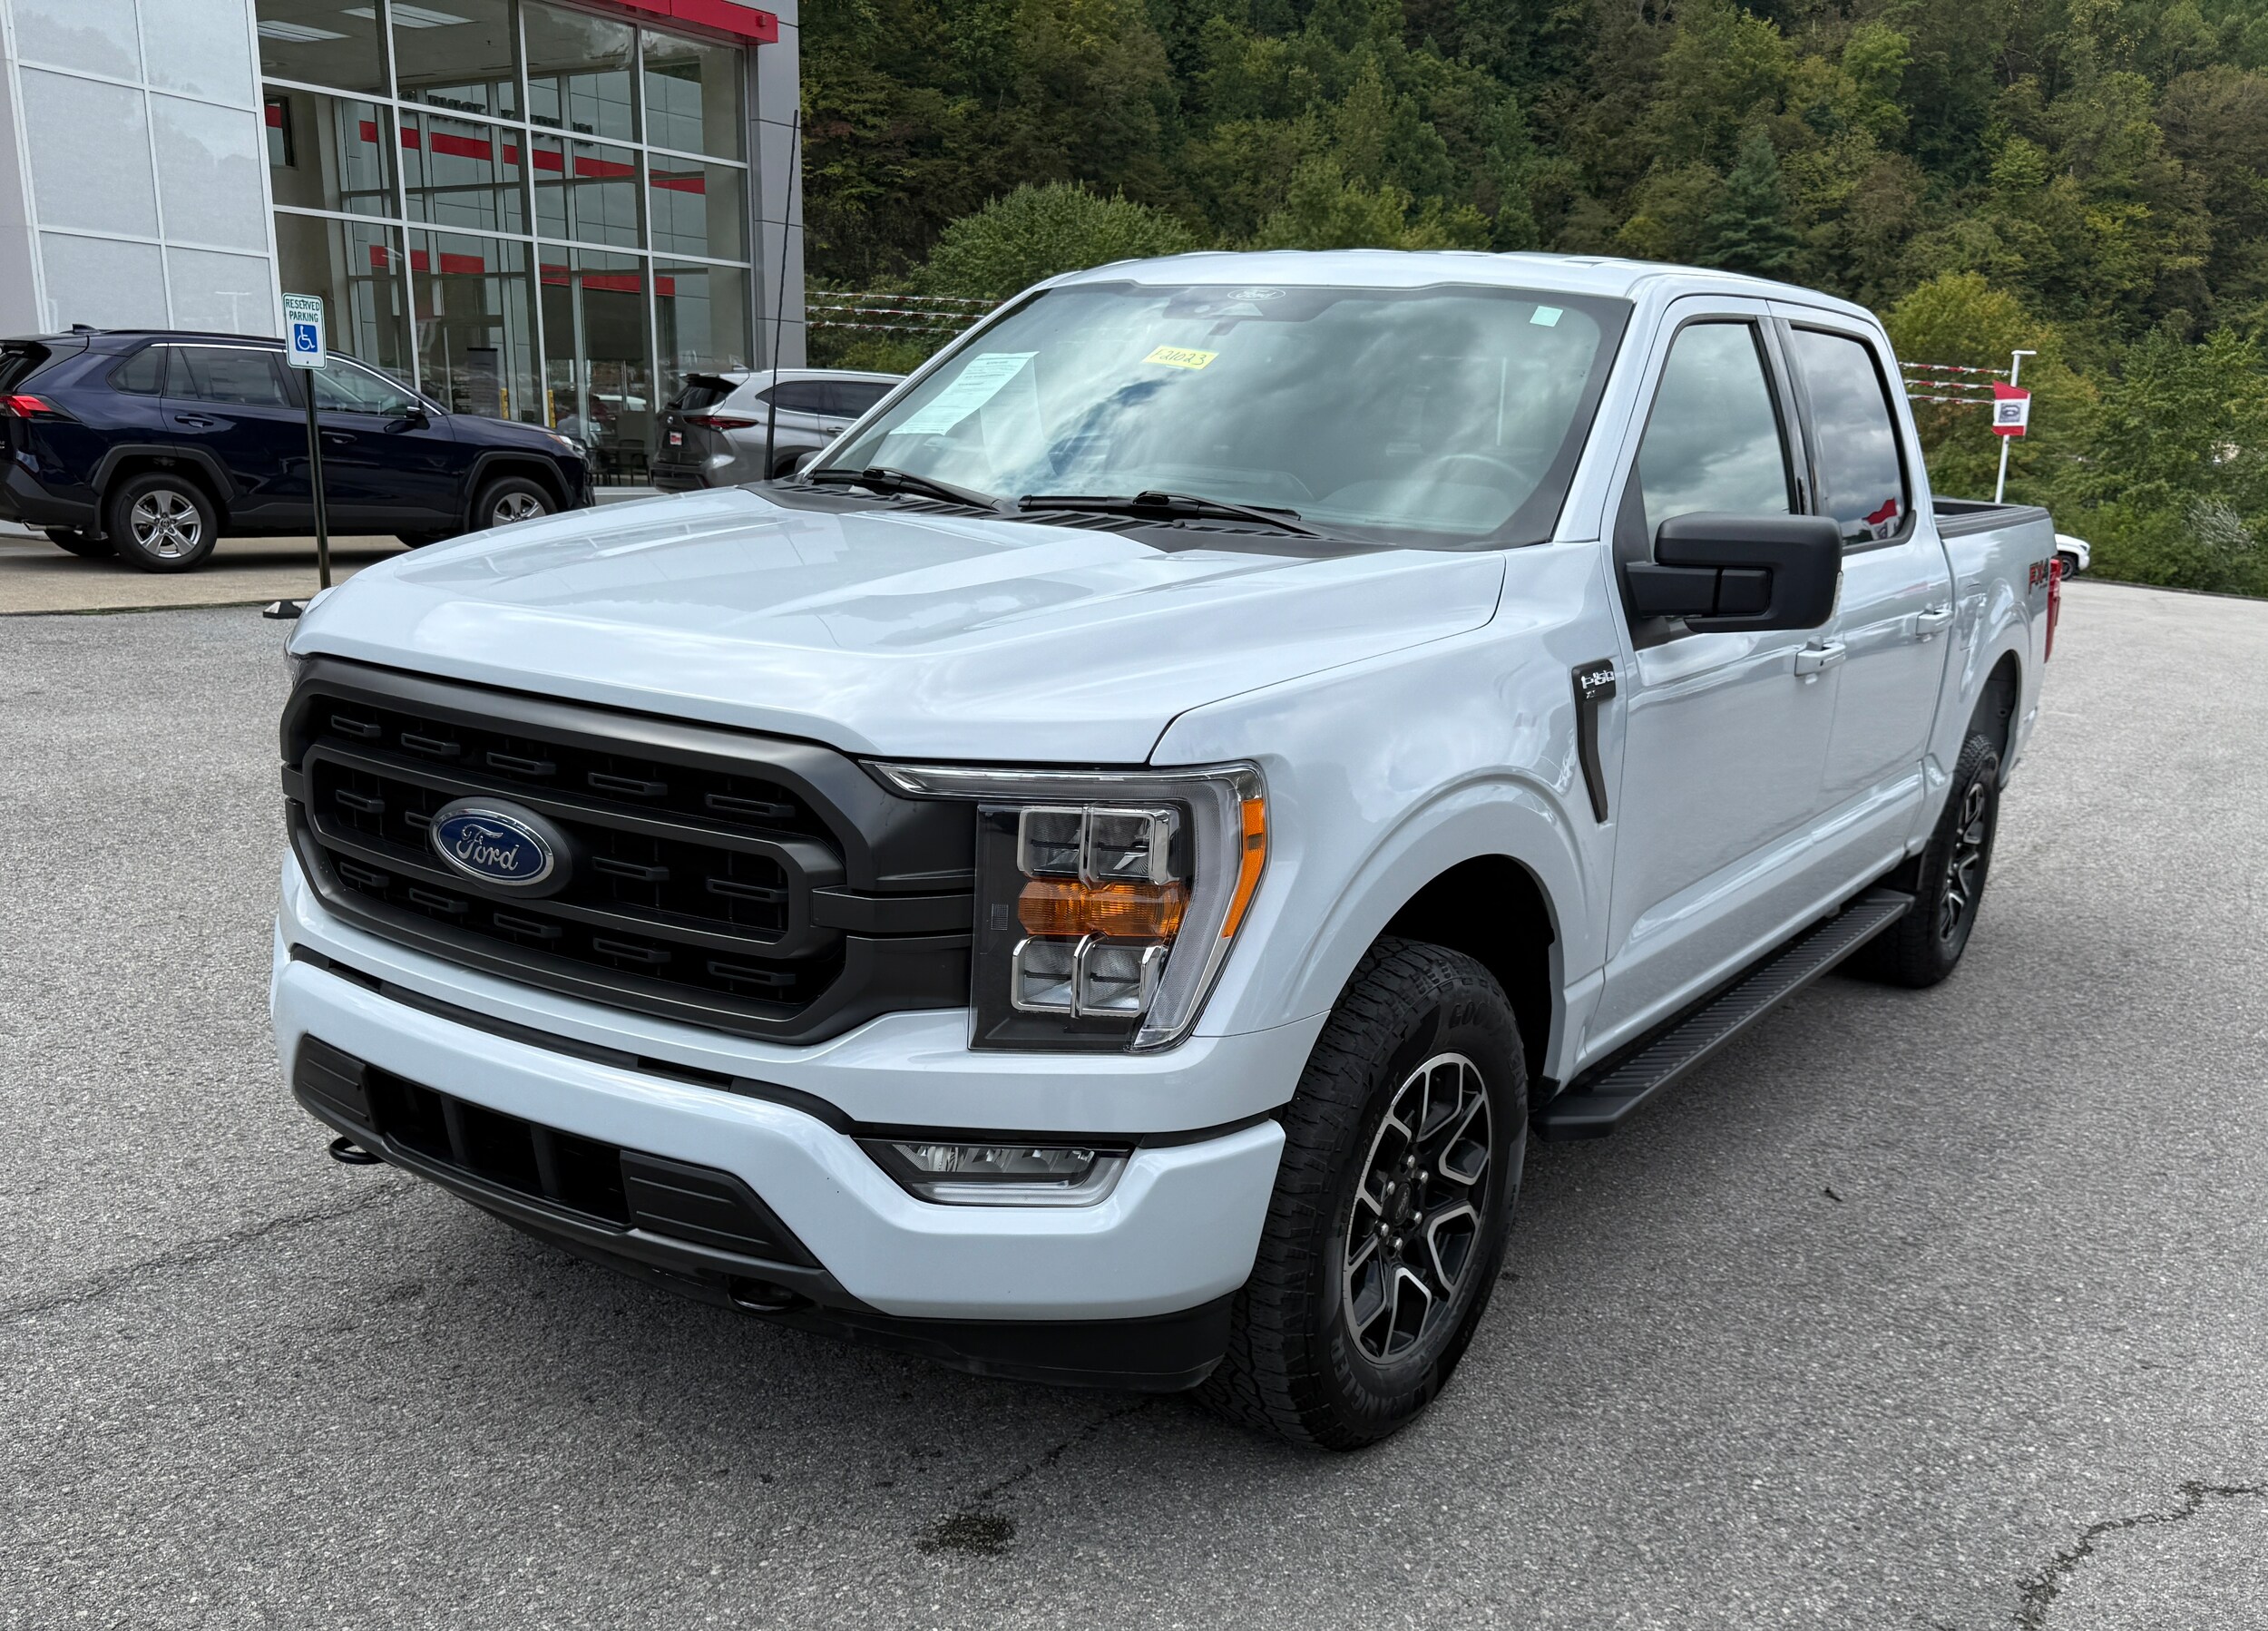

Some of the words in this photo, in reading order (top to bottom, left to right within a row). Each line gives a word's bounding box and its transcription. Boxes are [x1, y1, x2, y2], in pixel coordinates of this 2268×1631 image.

[285, 298, 320, 310] RESERVED
[288, 310, 319, 322] PARKING
[455, 823, 520, 872] Ford
